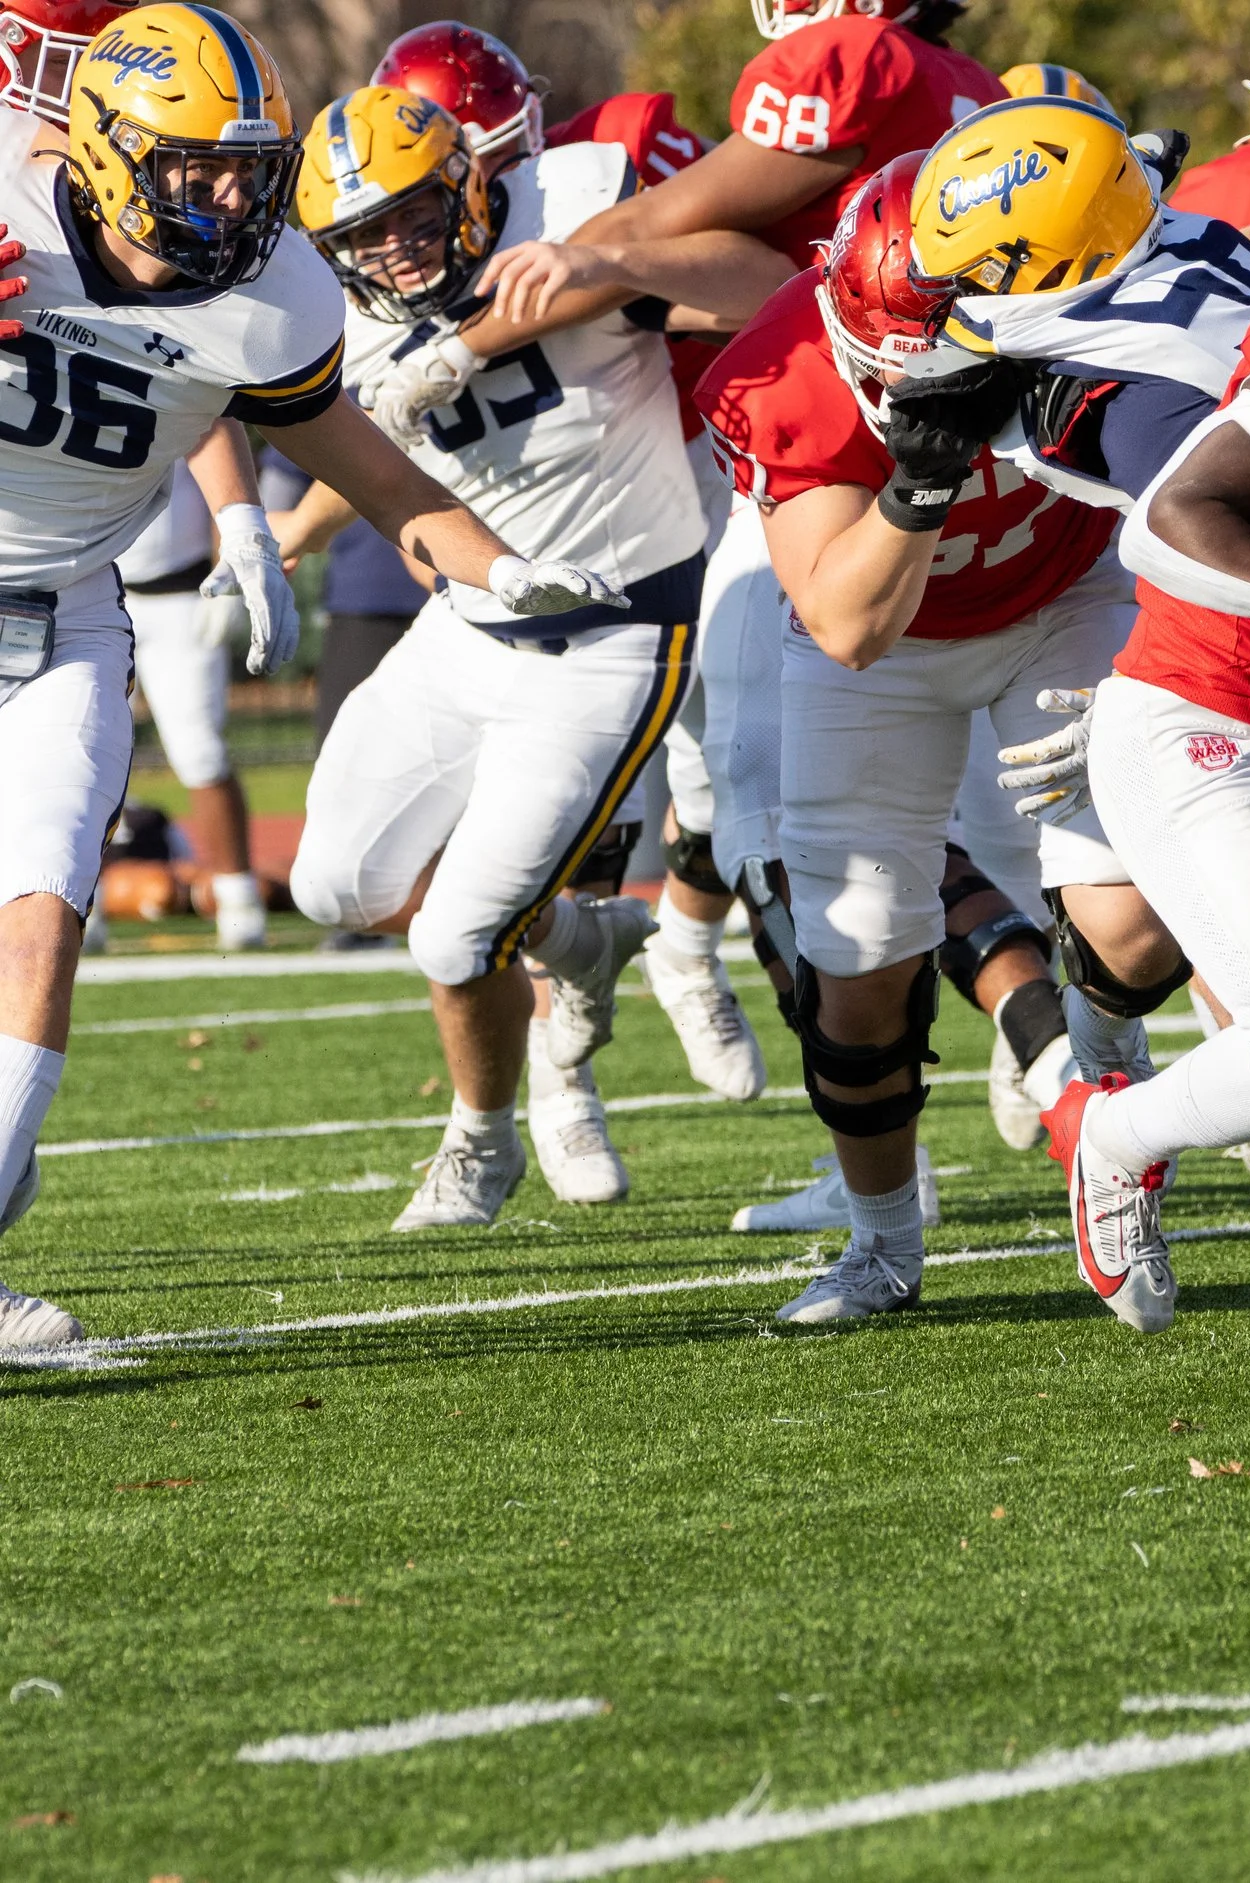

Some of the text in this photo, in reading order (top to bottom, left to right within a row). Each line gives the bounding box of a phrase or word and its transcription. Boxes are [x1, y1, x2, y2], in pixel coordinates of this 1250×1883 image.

[89, 29, 179, 87] Augie
[742, 81, 830, 154] 68
[938, 148, 1049, 222] Augie
[35, 308, 98, 348] VIKINGS
[893, 339, 930, 354] BEAR
[0, 331, 157, 469] 36
[910, 488, 953, 506] NIKE
[1187, 741, 1240, 763] WASH
